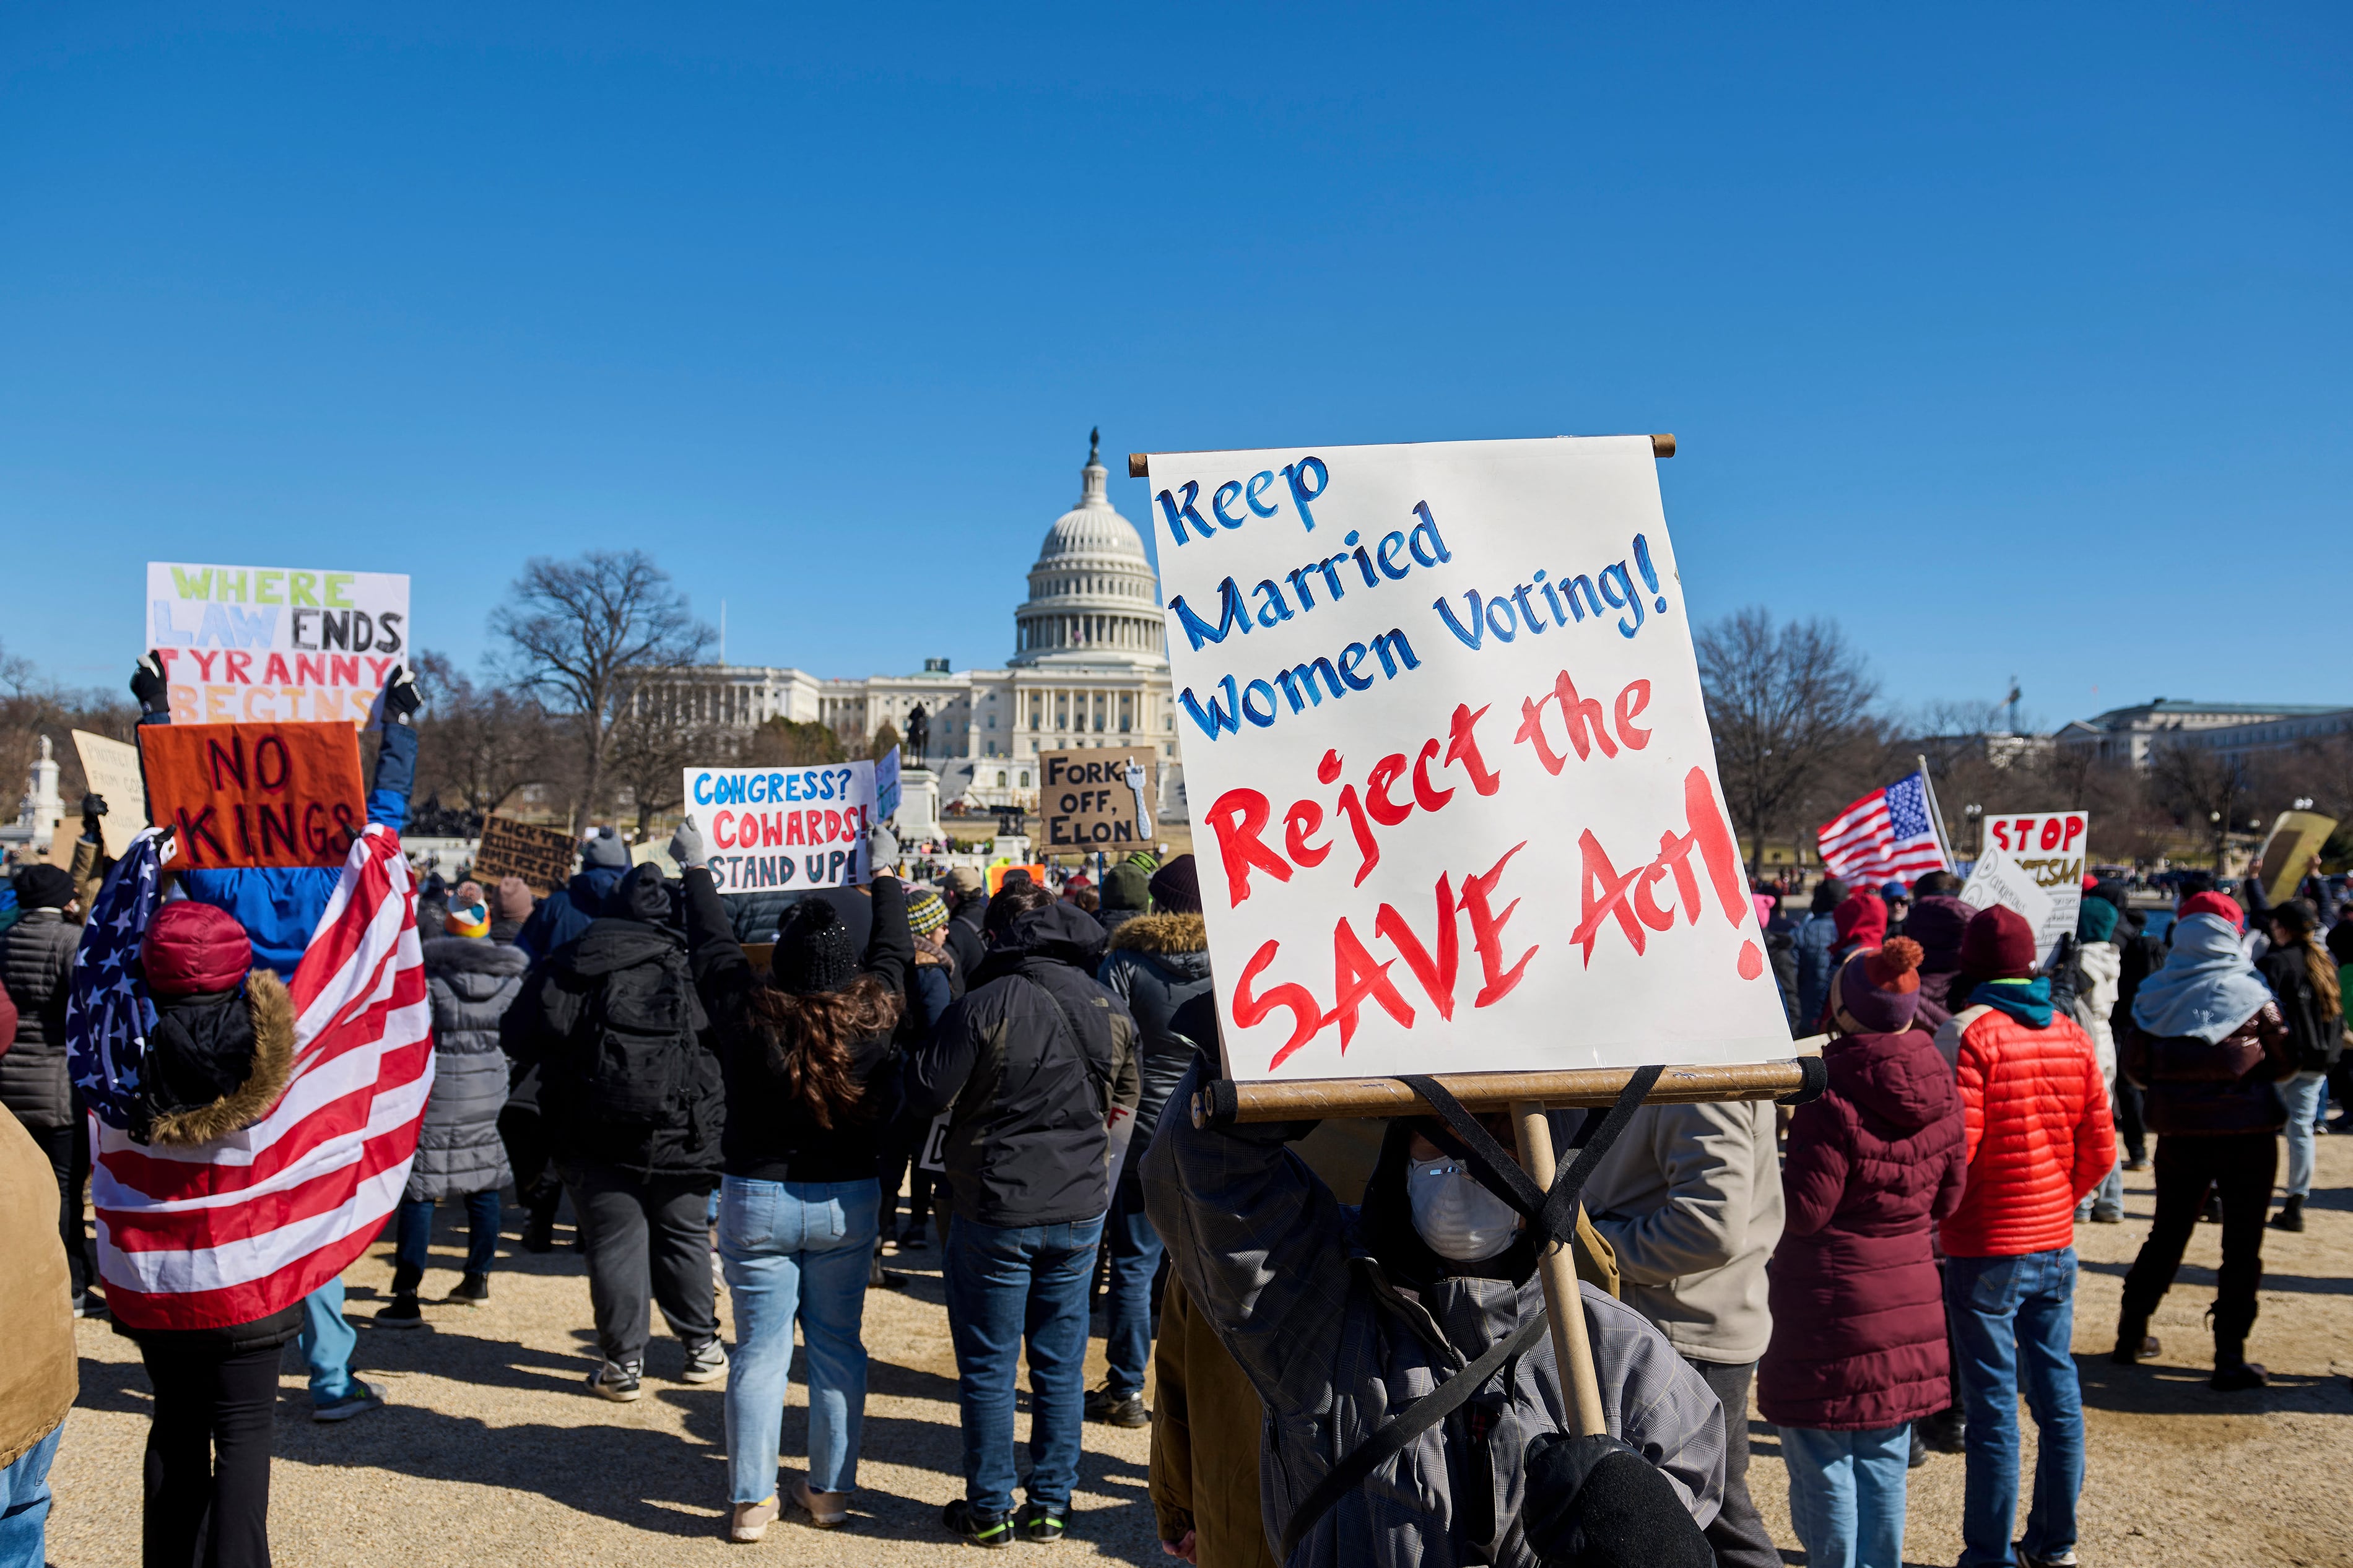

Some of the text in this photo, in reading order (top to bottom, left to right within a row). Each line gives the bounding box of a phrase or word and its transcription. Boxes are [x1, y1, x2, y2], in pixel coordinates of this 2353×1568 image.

[1154, 455, 1329, 547] Keep
[170, 566, 355, 609] WHERE
[1167, 499, 1452, 652] Married
[153, 599, 279, 649] LAW
[1178, 532, 1668, 742] Women Voting!
[151, 648, 395, 688] TYRANNY
[169, 685, 376, 730] BEGINS
[207, 734, 292, 795] NO
[694, 769, 852, 805] CONGRESS?
[1048, 756, 1123, 786] FORK
[1059, 790, 1117, 816] OFF,
[1205, 669, 1653, 909] Reject the
[176, 802, 355, 864] KINGS
[487, 816, 576, 850] FUCK YOU
[713, 804, 868, 850] COWARDS!
[1050, 815, 1132, 845] ELON
[1992, 816, 2084, 852] STOP
[480, 847, 565, 879] AMERICA
[707, 850, 858, 890] STAND UP!
[1975, 847, 2028, 915] Dangerous
[1232, 765, 1764, 1073] SAVE Act!
